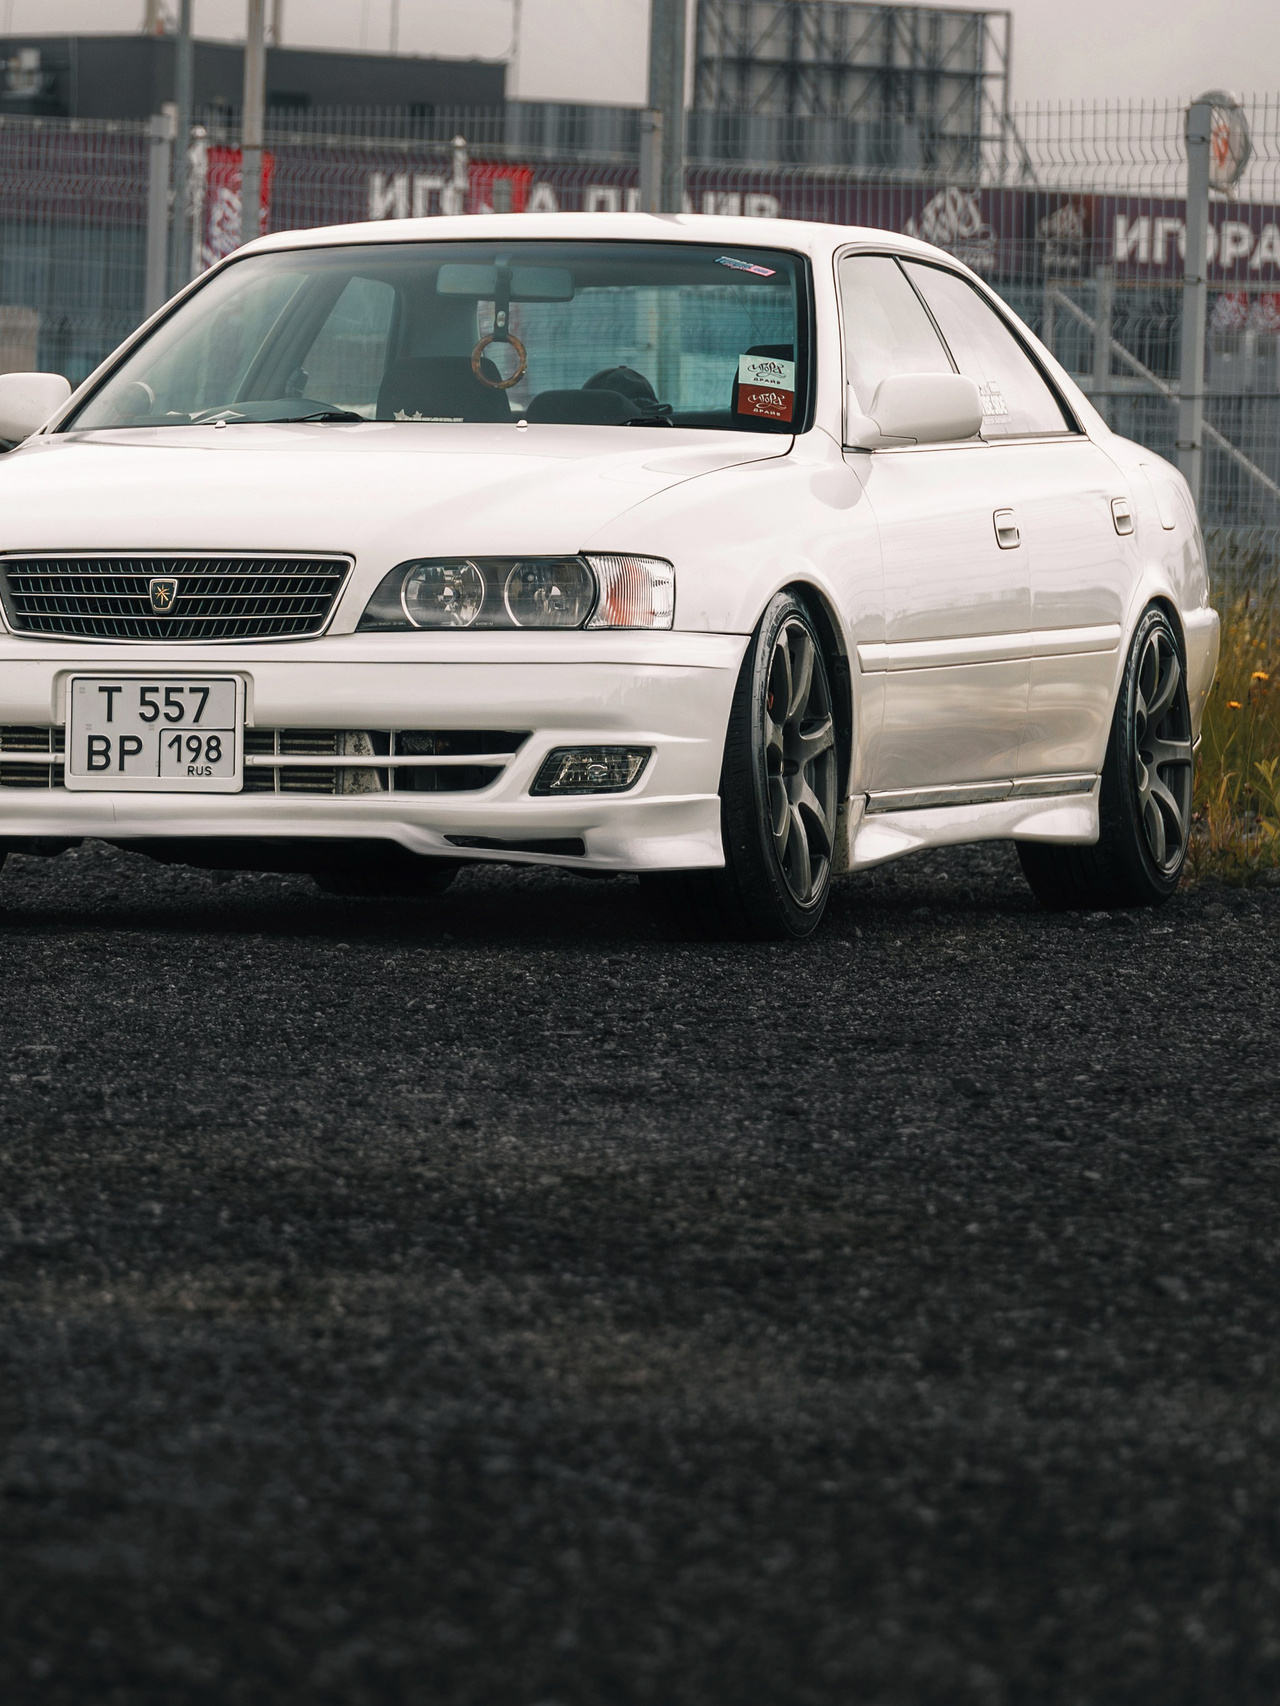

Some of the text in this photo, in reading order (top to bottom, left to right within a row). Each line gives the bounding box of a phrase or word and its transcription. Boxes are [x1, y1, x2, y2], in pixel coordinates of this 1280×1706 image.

[138, 686, 210, 723] 557
[167, 734, 222, 763] 198
[187, 765, 213, 776] RUS
